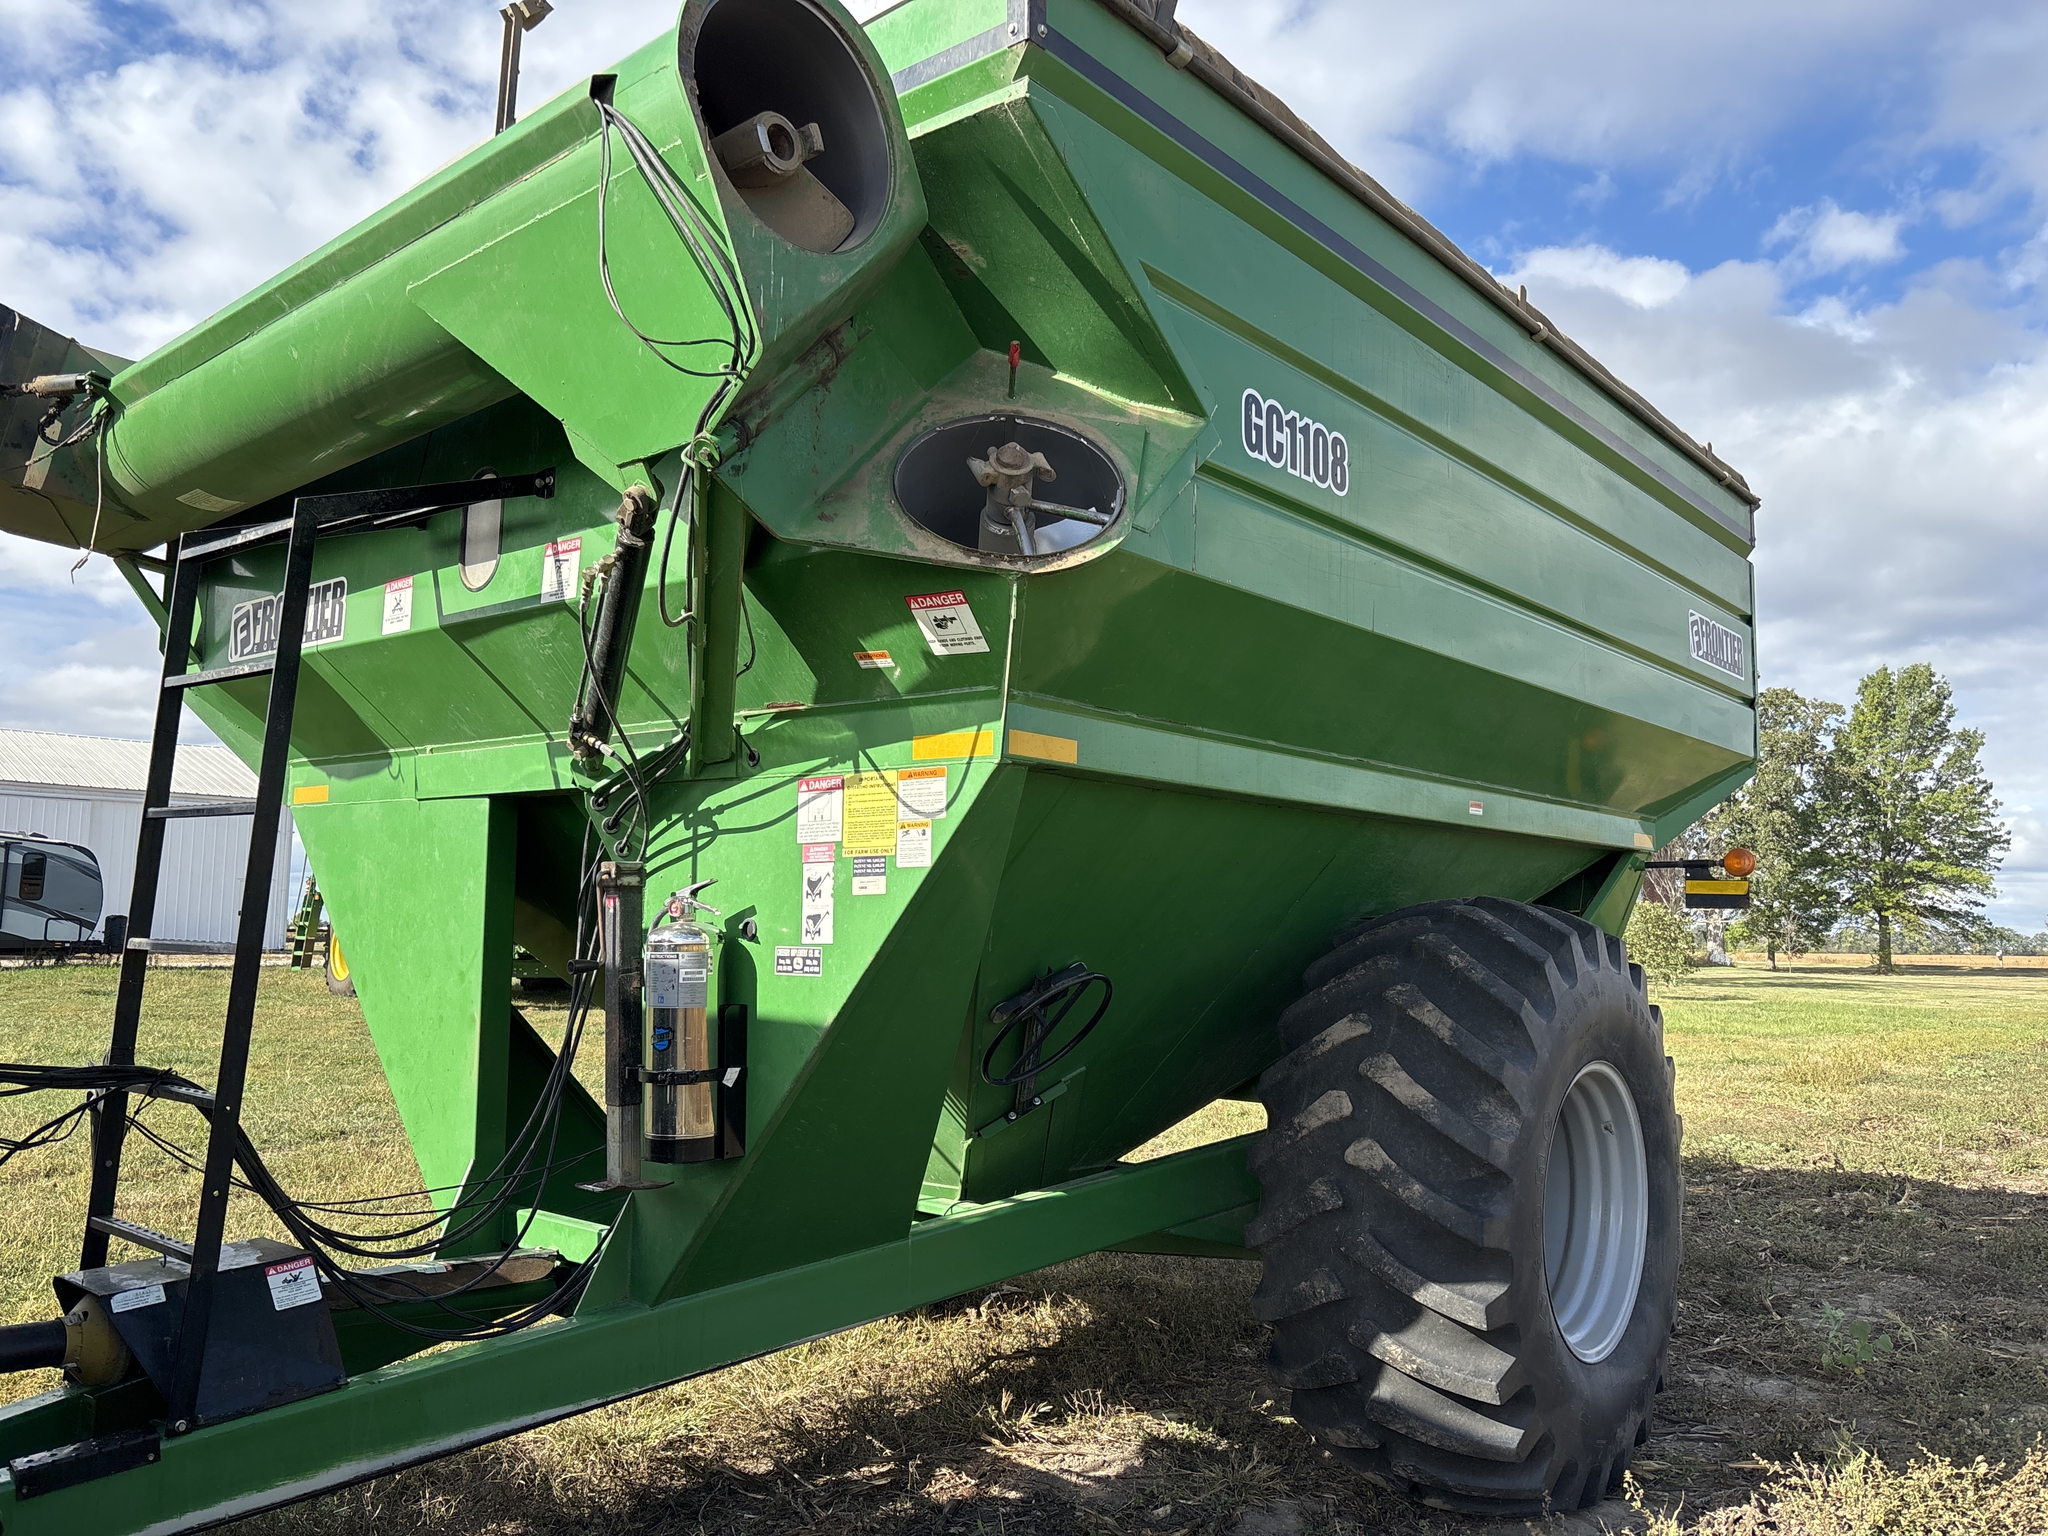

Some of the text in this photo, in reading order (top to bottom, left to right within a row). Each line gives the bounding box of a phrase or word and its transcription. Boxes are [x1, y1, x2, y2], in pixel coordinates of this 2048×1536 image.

[1243, 390, 1348, 496] GC1108
[552, 540, 581, 553] DANGER
[390, 579, 412, 592] DANGER
[917, 593, 966, 608] DANGER
[1699, 616, 1743, 672] FRONTIER
[809, 779, 842, 790] DANGER
[277, 1259, 310, 1272] DANGER
